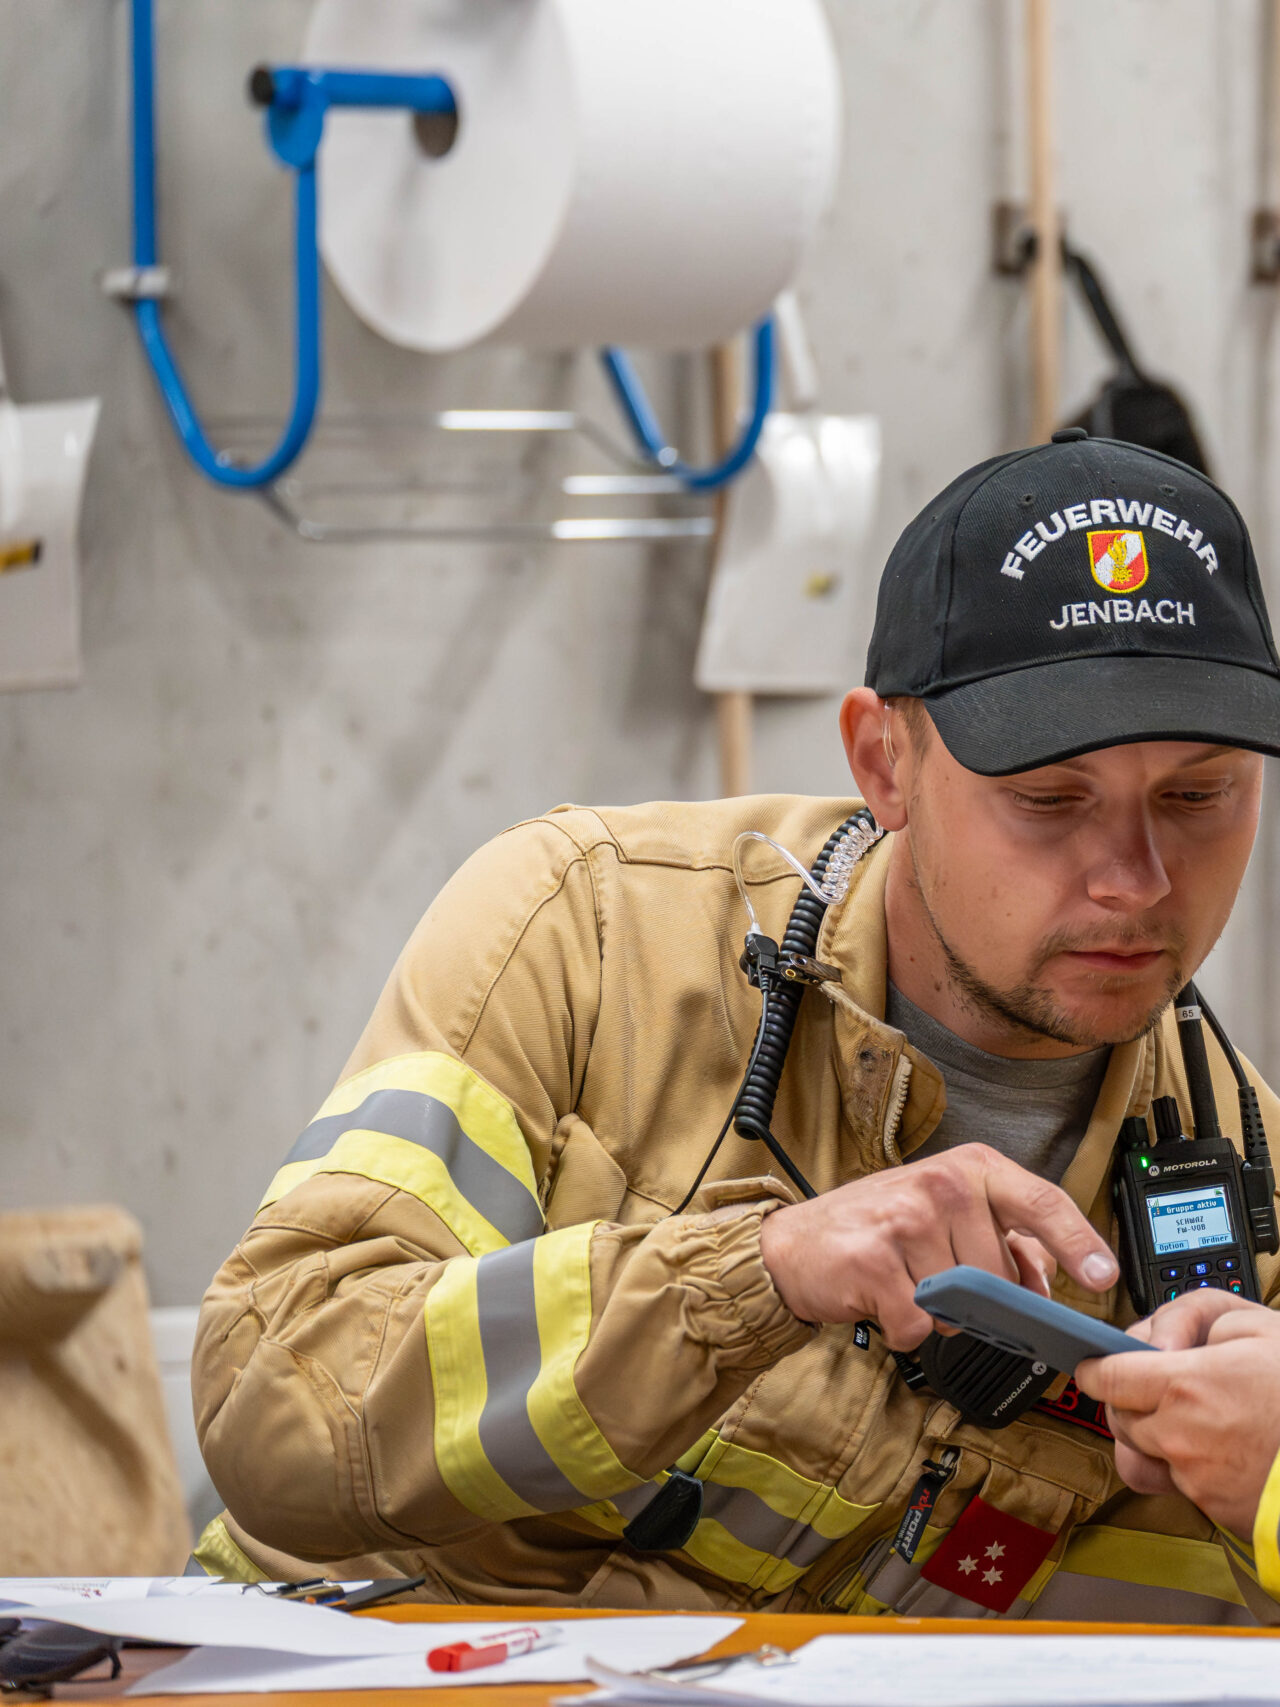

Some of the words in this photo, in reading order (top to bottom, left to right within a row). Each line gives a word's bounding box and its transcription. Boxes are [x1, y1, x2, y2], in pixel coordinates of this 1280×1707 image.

[1000, 498, 1219, 581] FEUERWEHR
[1049, 599, 1196, 631] JENBACH
[1182, 1009, 1194, 1019] 65
[1163, 1158, 1218, 1173] MOTOROLA
[1166, 1203, 1195, 1214] Gruppe
[1196, 1200, 1217, 1210] aktiv
[1175, 1216, 1204, 1227] SCHWAZ
[1159, 1242, 1185, 1252] Option
[1201, 1235, 1229, 1245] Ordner
[992, 1374, 1033, 1417] MOTOROLA
